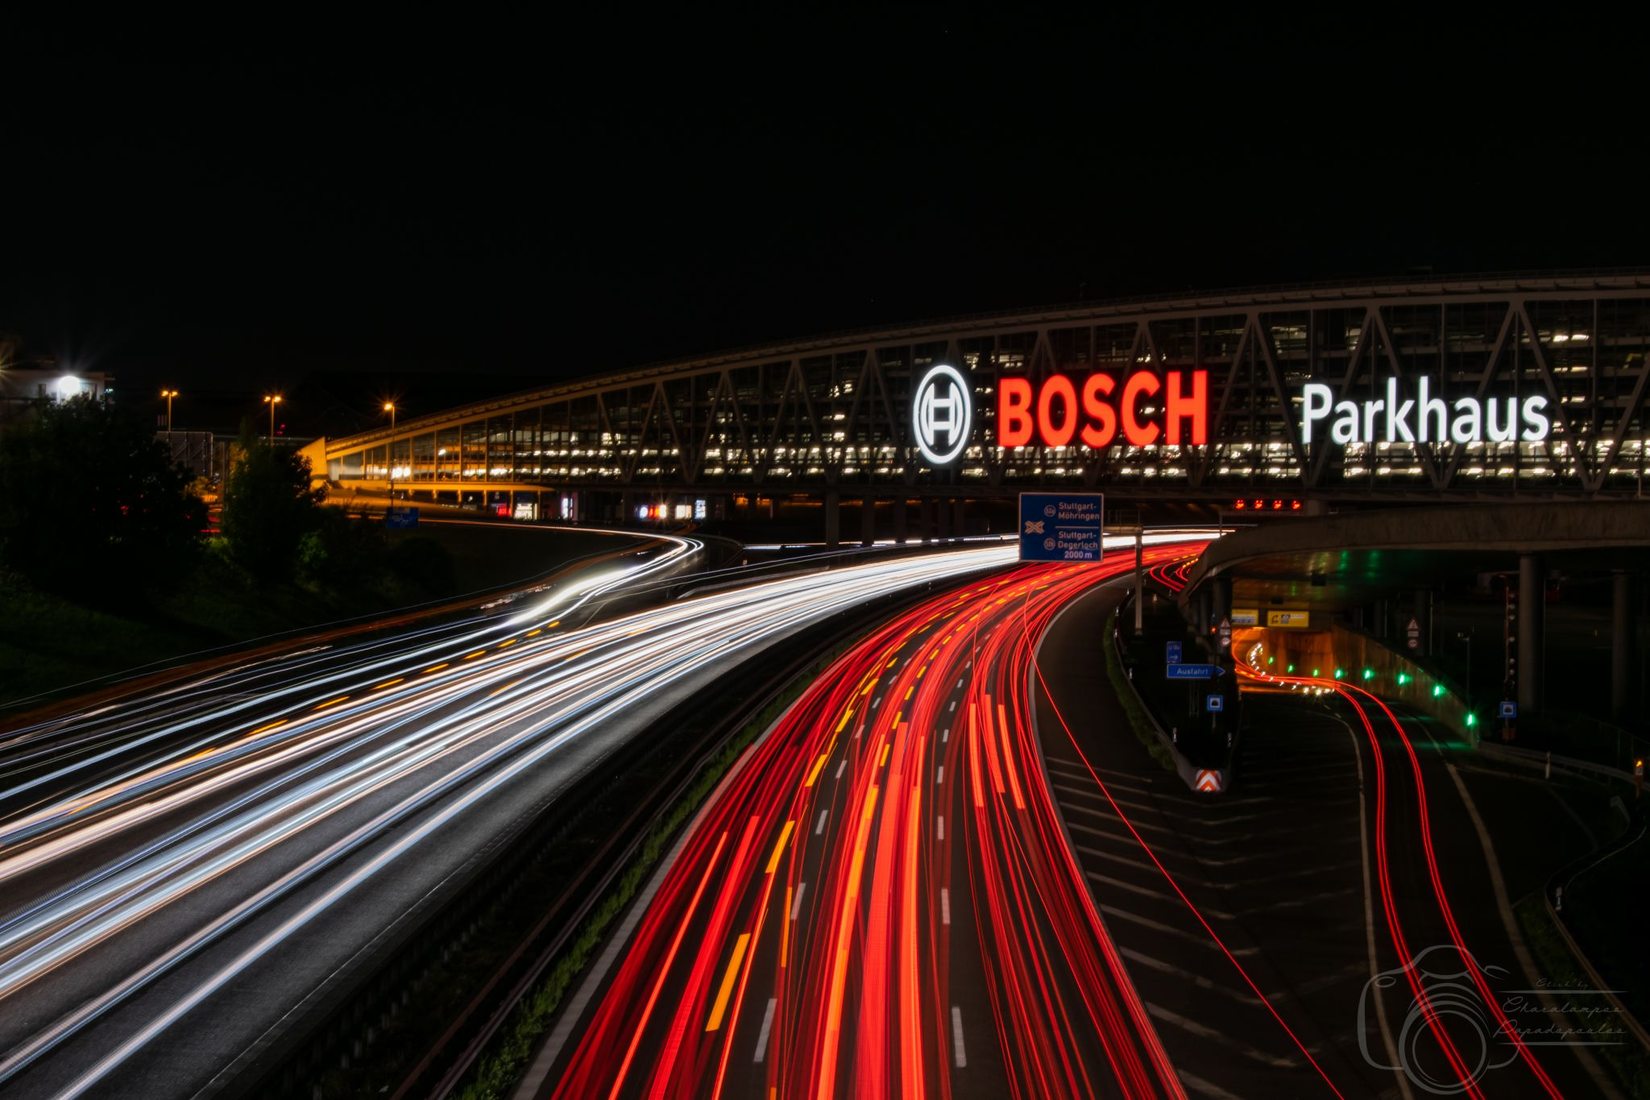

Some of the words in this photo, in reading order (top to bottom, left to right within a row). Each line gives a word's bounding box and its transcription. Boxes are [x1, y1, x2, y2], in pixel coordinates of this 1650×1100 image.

[998, 370, 1209, 449] BOSCH
[1302, 376, 1551, 445] Parkhaus
[1058, 502, 1097, 511] Stuttgart-
[1058, 511, 1100, 521] Möhringen
[1058, 531, 1097, 540] Stuttgart-
[1057, 541, 1098, 550] Degerloch
[1064, 551, 1083, 559] 2000
[1176, 667, 1209, 675] Ausfahrt
